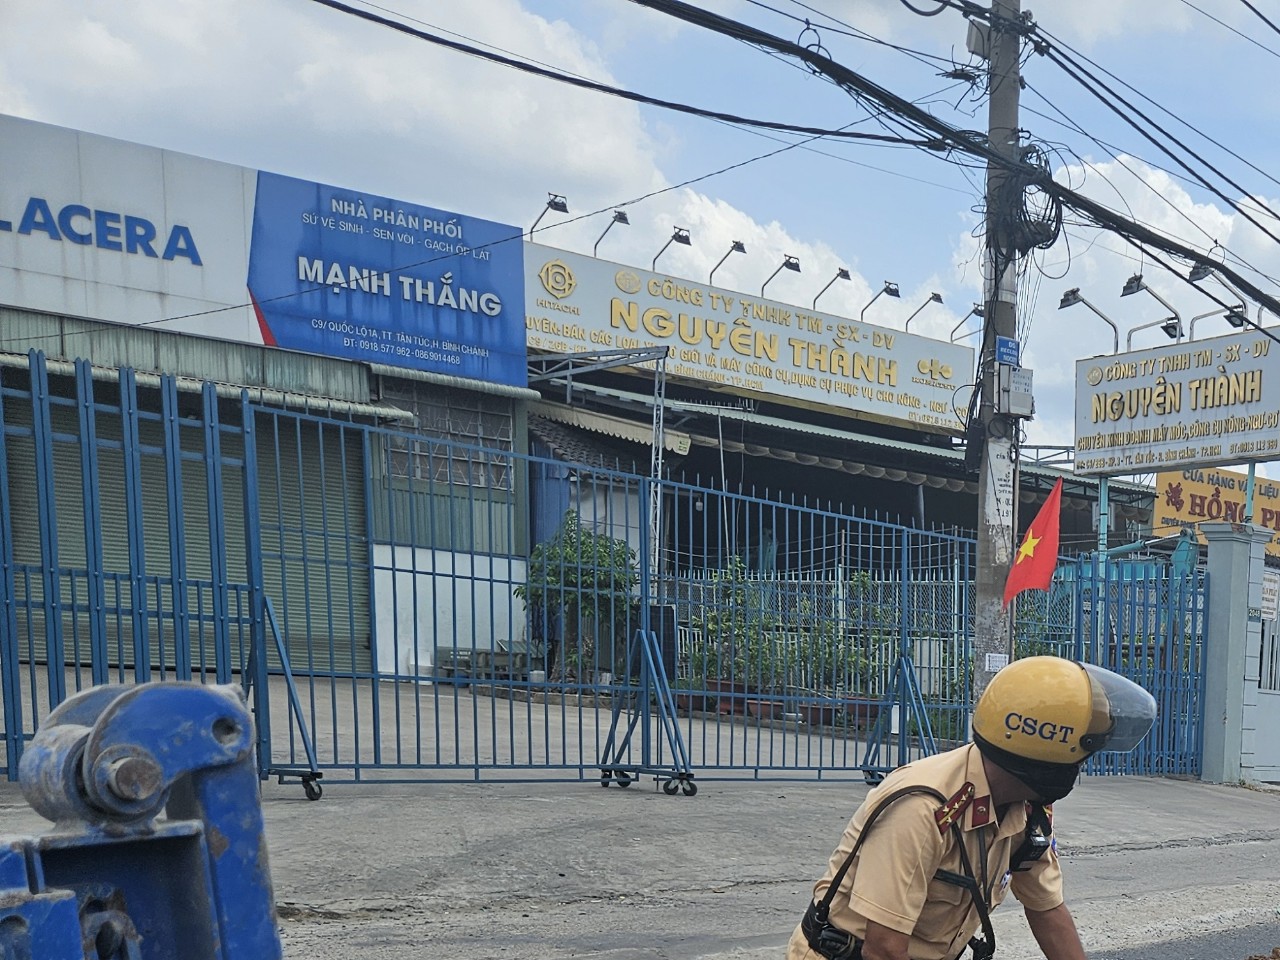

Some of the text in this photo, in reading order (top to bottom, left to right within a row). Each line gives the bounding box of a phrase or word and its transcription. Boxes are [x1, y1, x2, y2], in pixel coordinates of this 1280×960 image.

[302, 212, 319, 225] SỨ
[321, 216, 336, 230] VỆ
[339, 220, 363, 234] SINH
[373, 228, 394, 240] SEN
[397, 232, 414, 244] VÒI
[424, 239, 453, 252] GẠCH
[473, 248, 490, 261] LÁT
[331, 198, 462, 239] NHÀ PHÂN PHỐI
[298, 256, 502, 317] MẠNH THẮNG
[536, 298, 580, 316] HITACHI
[647, 278, 703, 307] CÔNG
[709, 292, 734, 313] TY
[795, 313, 823, 334] TM
[836, 322, 860, 343] SX
[872, 331, 895, 350] DV
[328, 320, 354, 334] QUỐC
[442, 339, 460, 352] BÌNH
[461, 344, 489, 358] CHÁNH
[343, 337, 358, 347] ĐT:
[360, 340, 378, 351] 0918
[381, 344, 395, 353] 577
[610, 297, 897, 387] NGUYÊN THÀNH
[526, 315, 561, 337] UYÊN:
[562, 323, 586, 341] BÁN
[590, 330, 613, 347] CÁC
[705, 352, 717, 368] VÀ
[721, 356, 741, 372] MÁY
[745, 362, 772, 379] CÔNG
[820, 378, 832, 394] CỤ
[834, 381, 859, 397] PHỤC
[861, 386, 873, 402] VỤ
[876, 390, 894, 404] CHO
[896, 392, 921, 409] NÔNG
[1104, 360, 1137, 382] CÔNG
[1140, 358, 1156, 376] TY
[1159, 353, 1190, 373] TNHH
[1193, 349, 1212, 368] TM
[1225, 344, 1241, 363] SX
[1252, 339, 1271, 358] DV
[1091, 365, 1262, 424] NGUYÊN THÀNH
[1078, 432, 1106, 451] CHUYÊN
[1106, 433, 1125, 448] KINH
[1124, 428, 1151, 446] DOANH
[1152, 423, 1169, 442] MÁY
[1212, 419, 1223, 438] CỤ
[1207, 472, 1236, 490] HÀNG
[1258, 483, 1279, 500] LIỆU
[1005, 712, 1074, 744] CSGT
